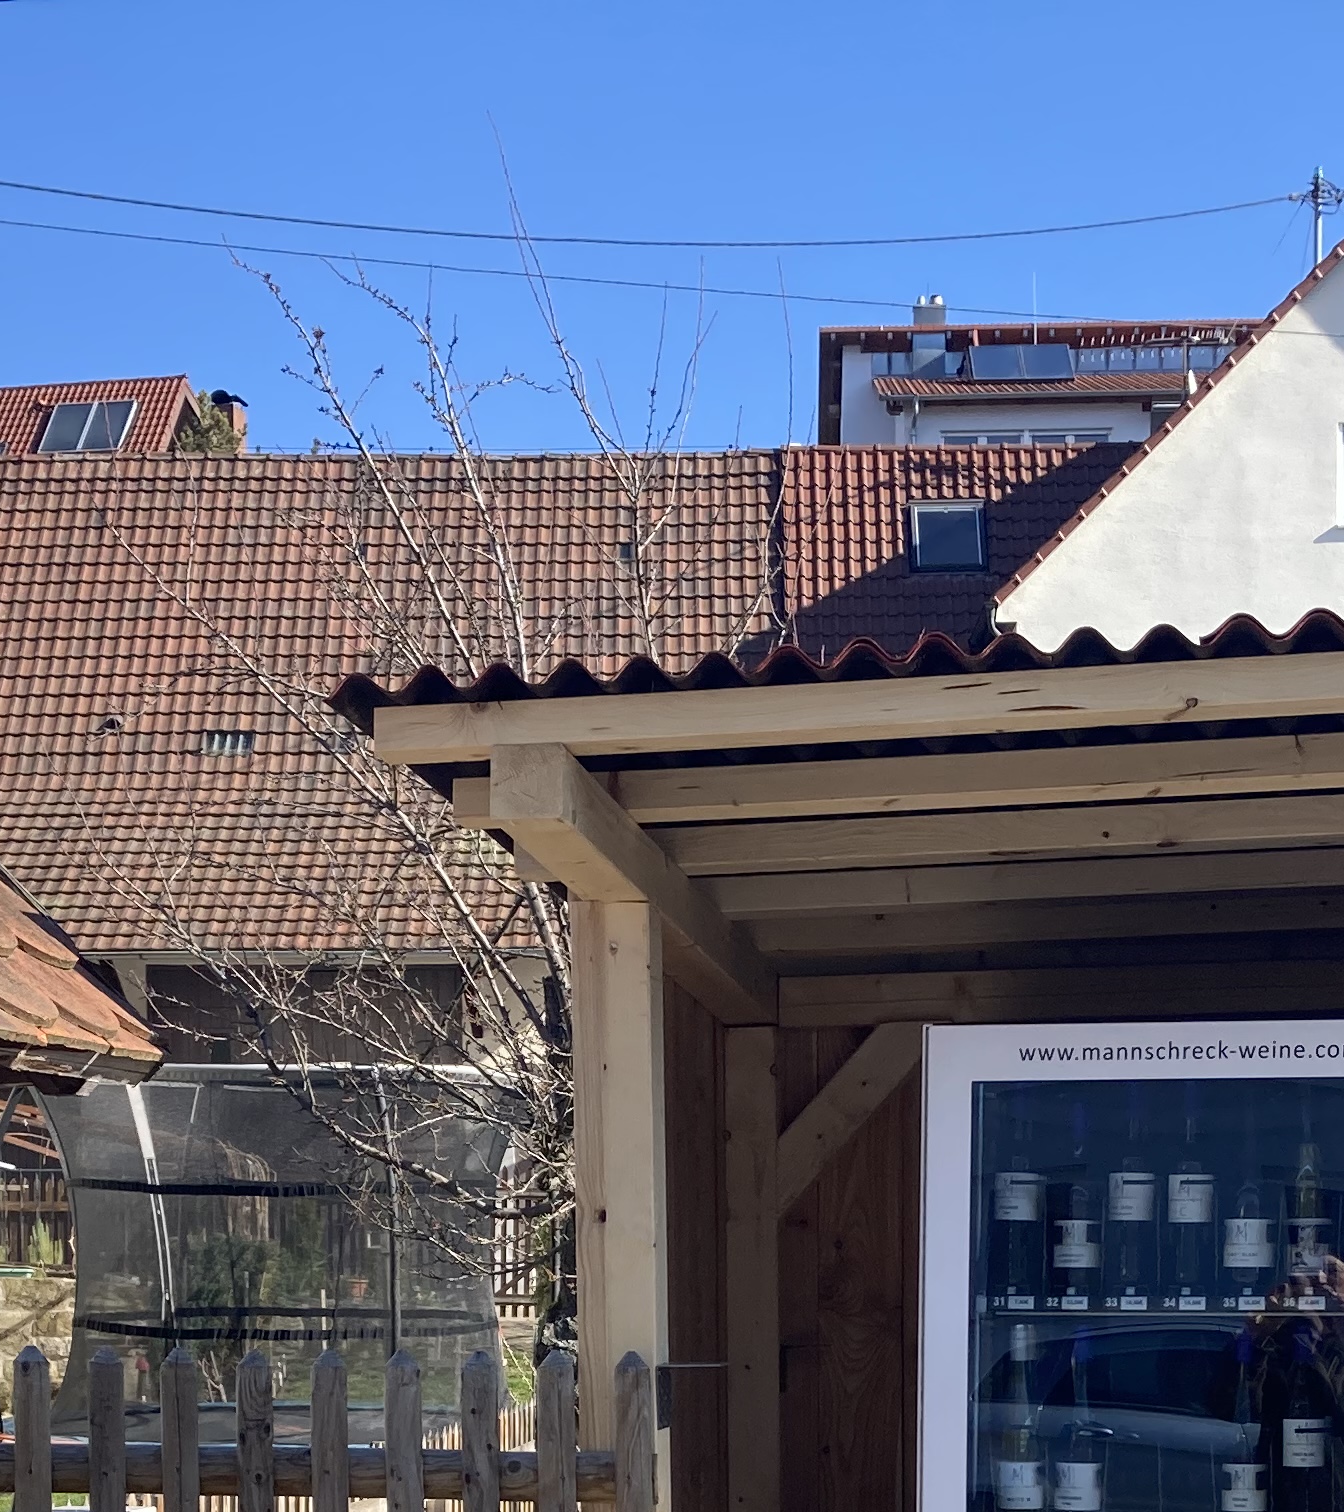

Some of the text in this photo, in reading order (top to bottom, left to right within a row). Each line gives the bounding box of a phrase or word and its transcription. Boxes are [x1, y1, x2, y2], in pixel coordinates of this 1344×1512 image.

[993, 1297, 1005, 1307] 31
[1046, 1297, 1059, 1307] 32
[1105, 1297, 1118, 1307] 33
[1163, 1297, 1176, 1307] 34
[1222, 1297, 1236, 1307] 35
